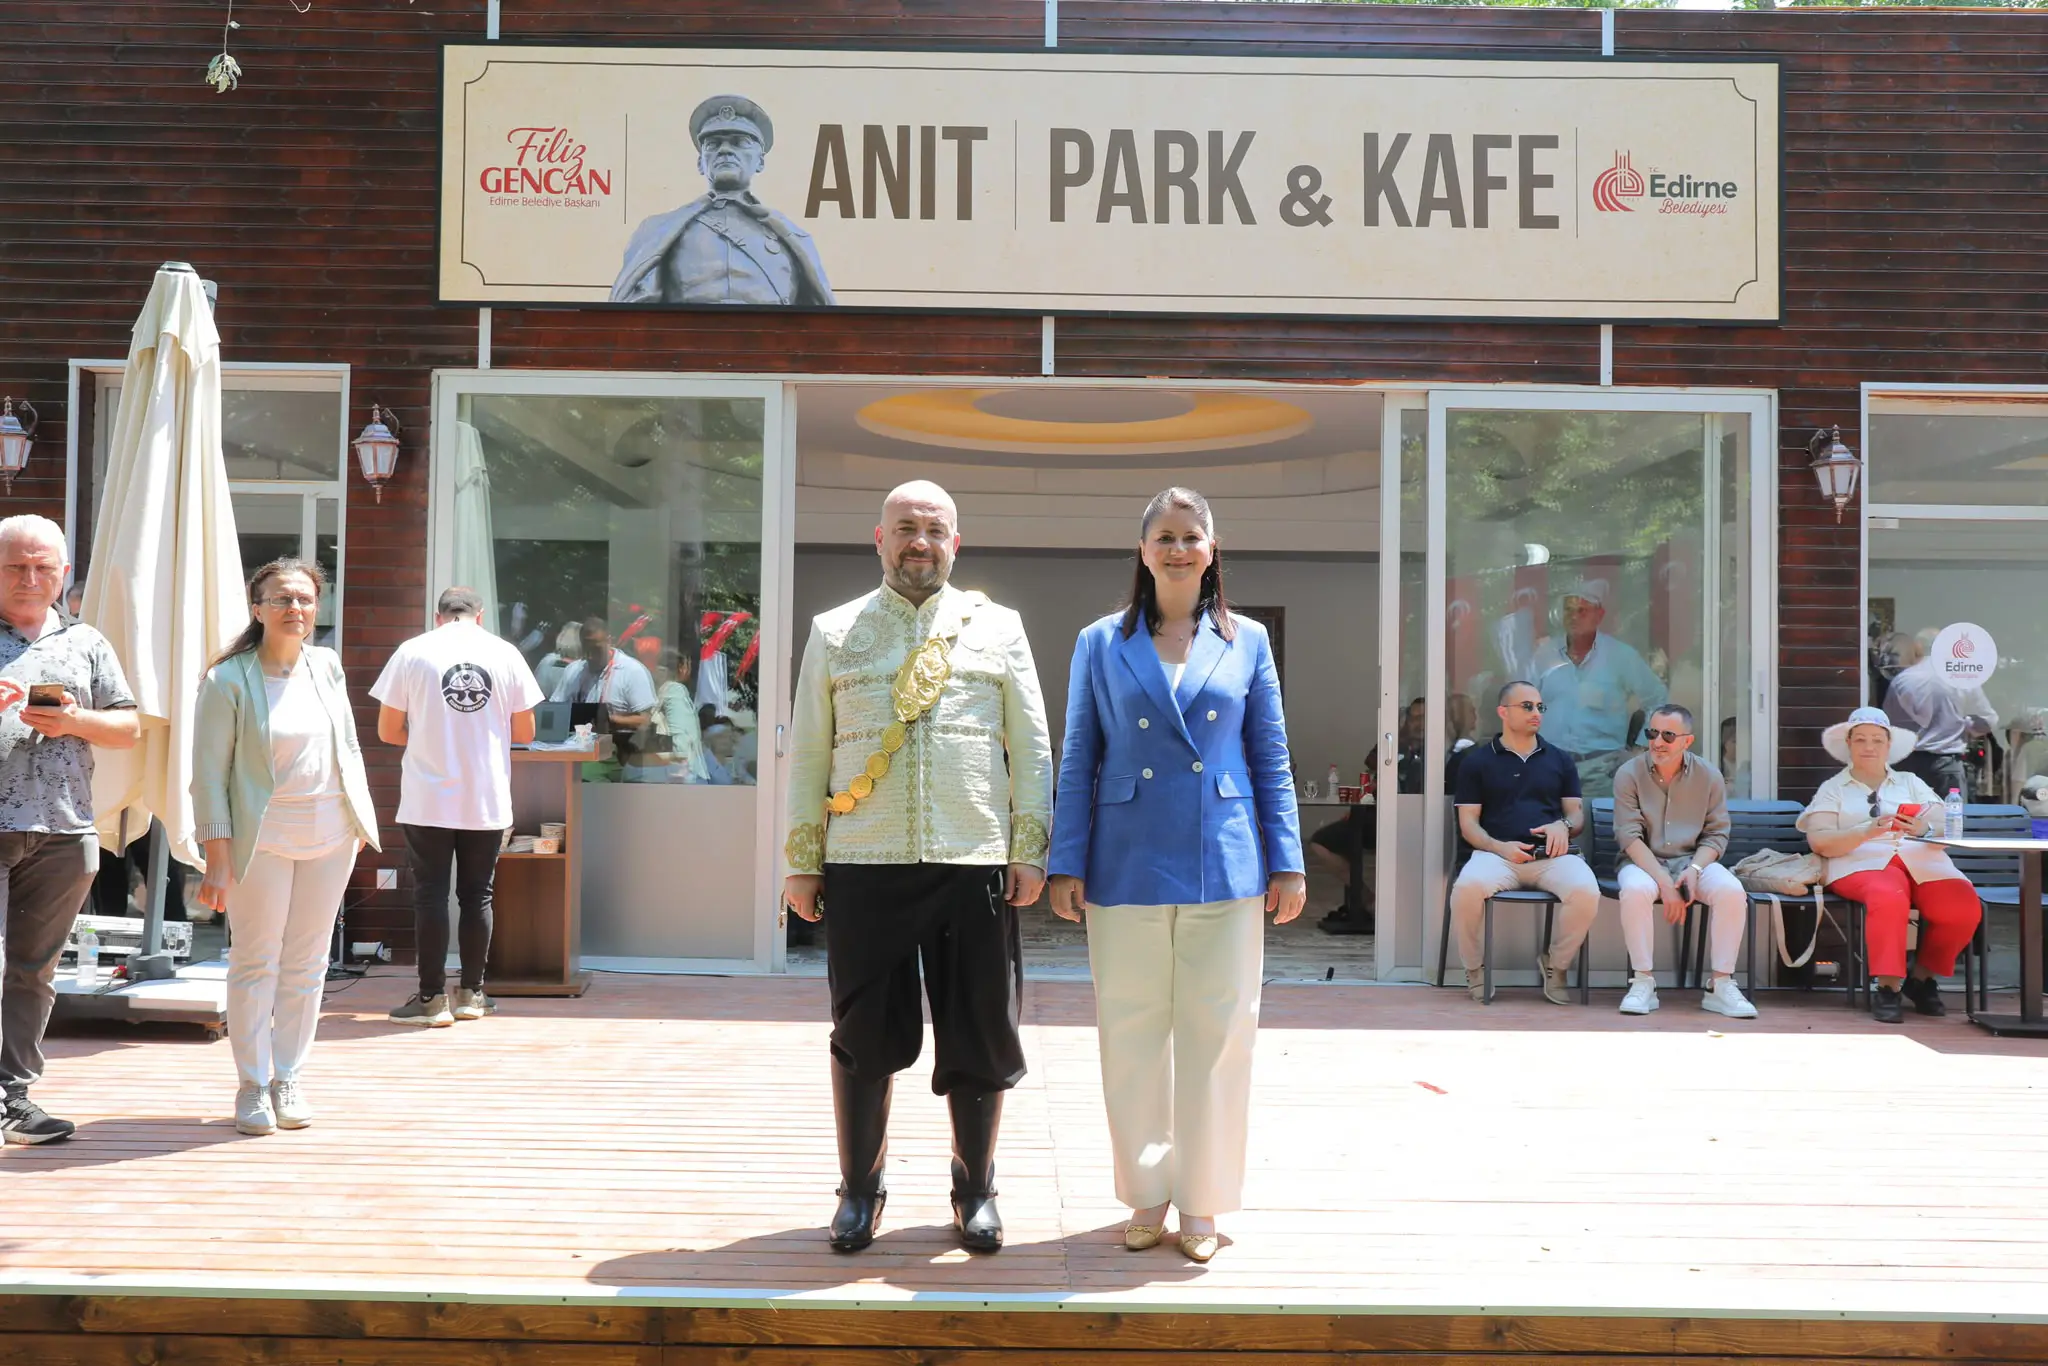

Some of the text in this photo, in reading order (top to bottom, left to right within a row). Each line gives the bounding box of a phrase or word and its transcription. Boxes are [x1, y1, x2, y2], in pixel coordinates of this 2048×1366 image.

[507, 126, 587, 180] Filiz
[480, 167, 611, 195] GENCAN
[804, 124, 1559, 229] ANIT PARK & KAFE
[1650, 174, 1738, 198] Edirne
[521, 197, 562, 208] Belediye
[1659, 198, 1728, 218] Belediyesi
[1945, 661, 1984, 672] Edirne
